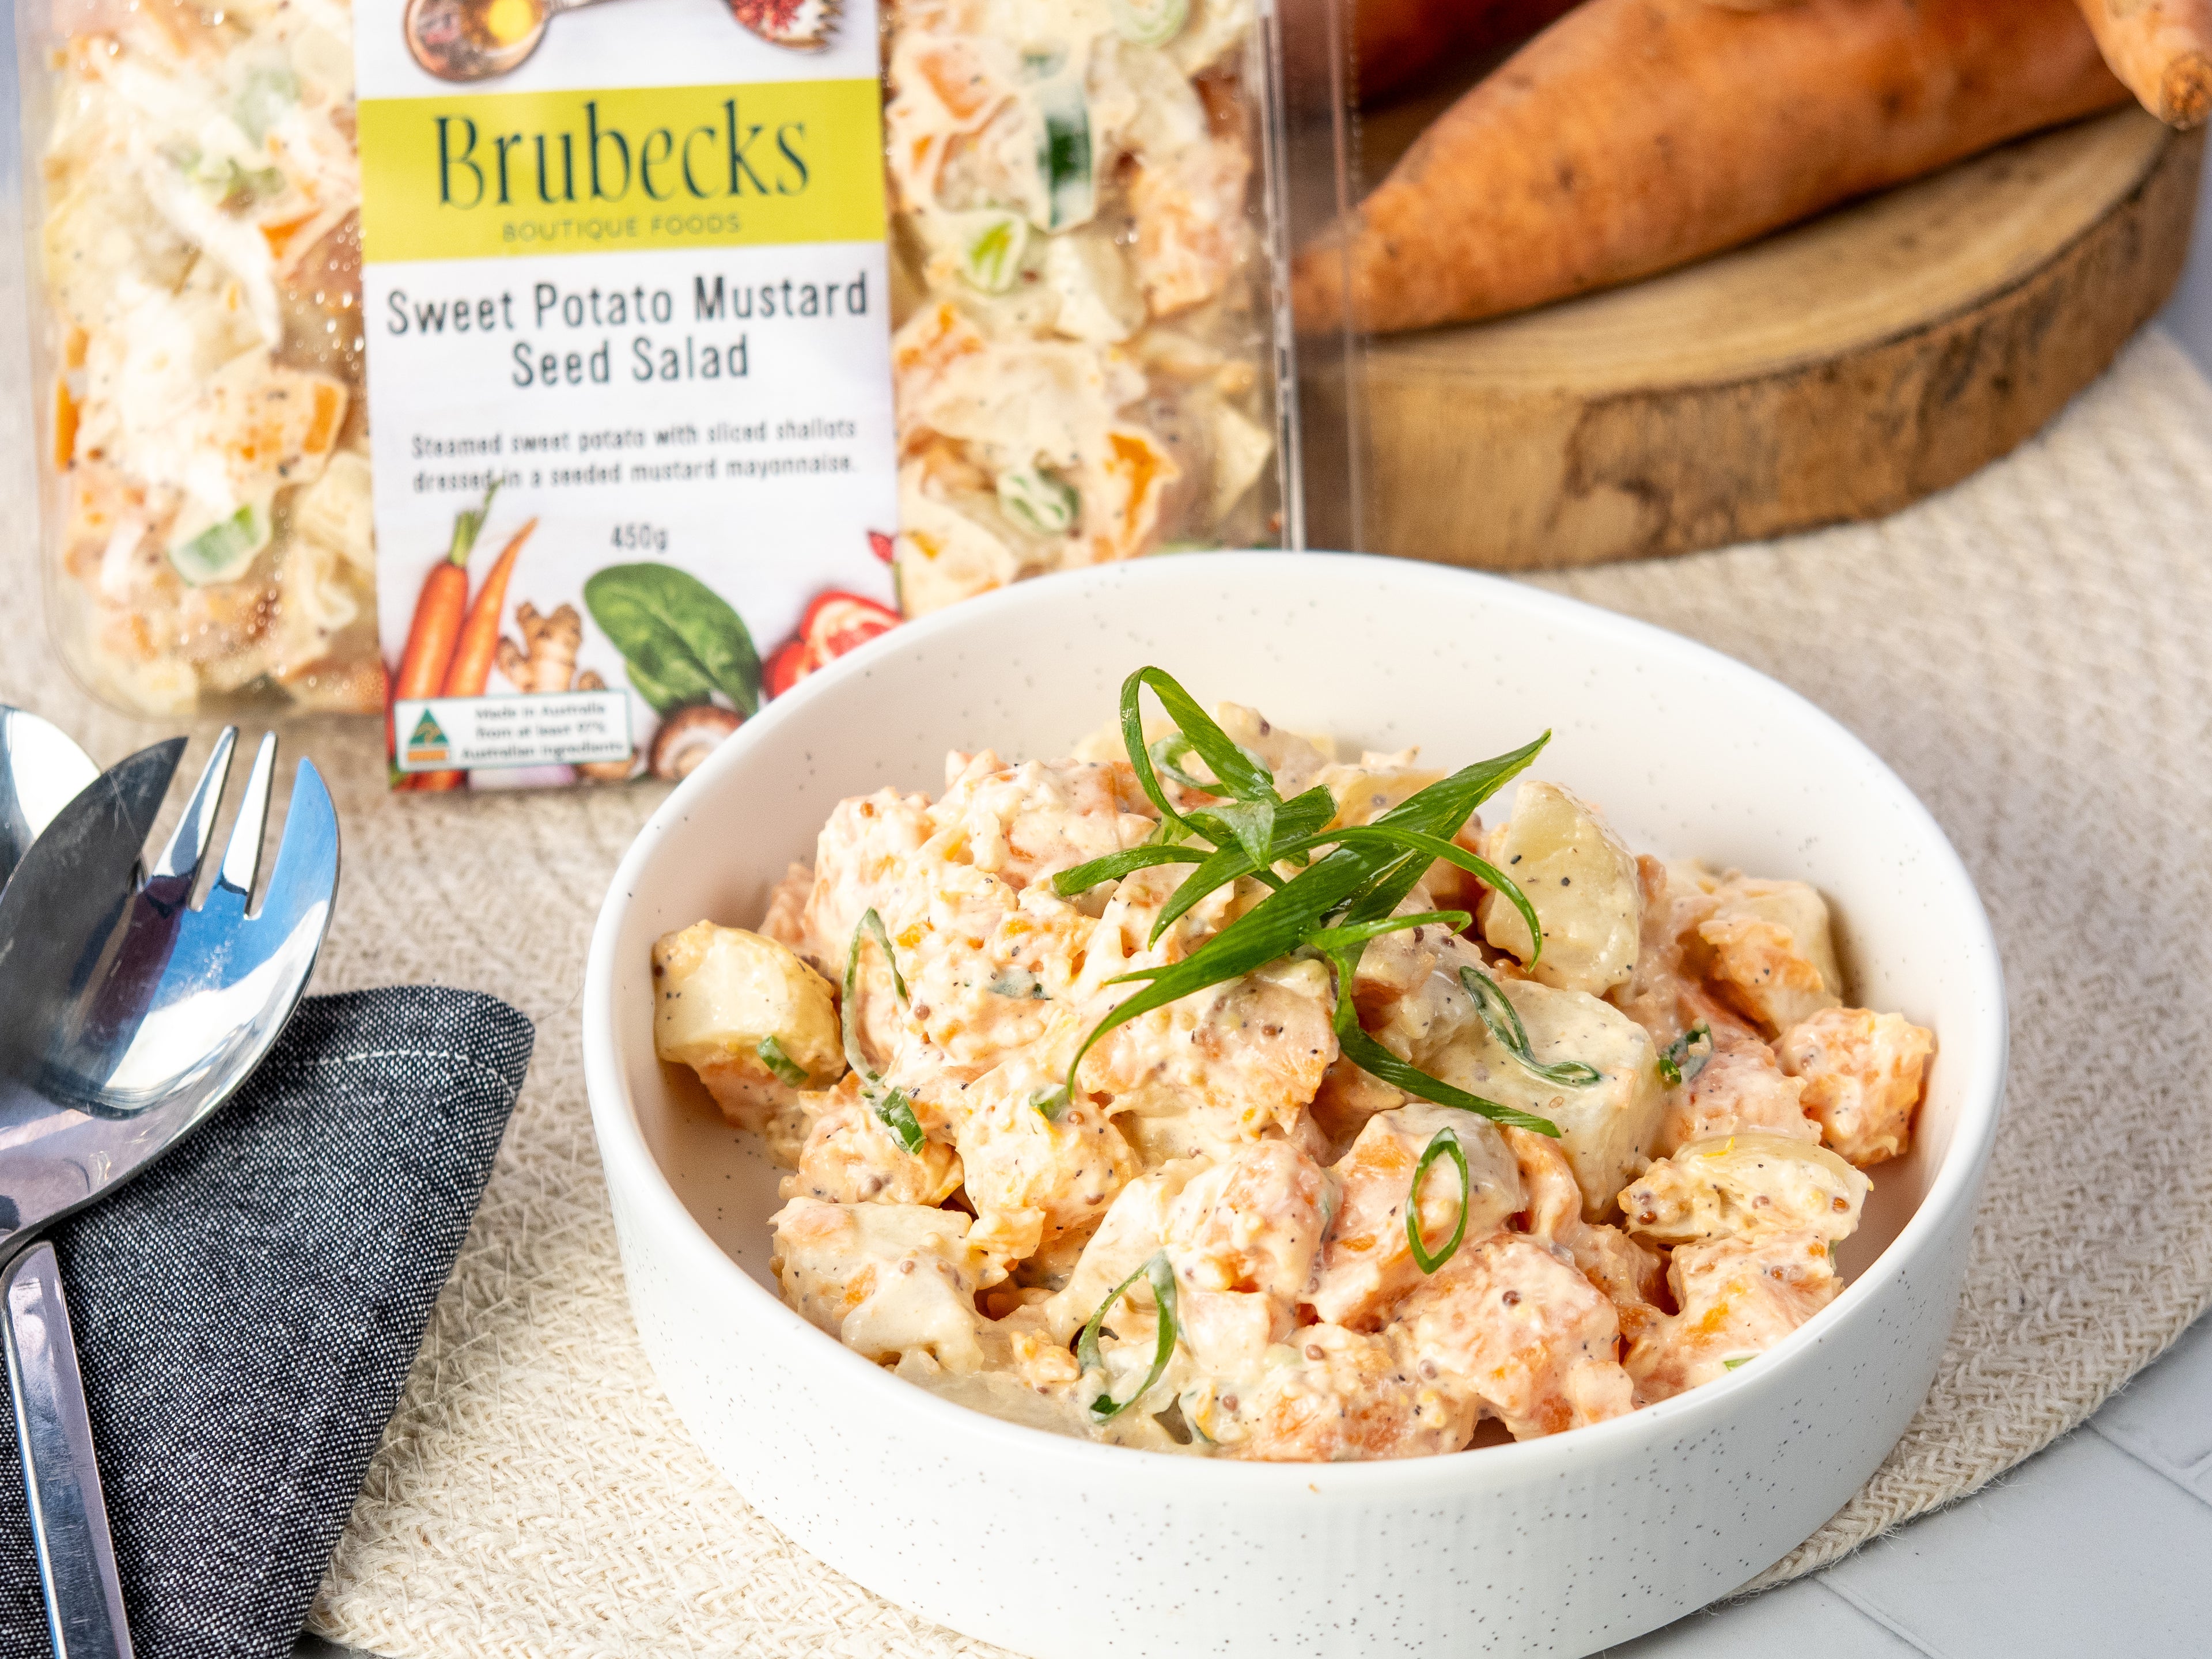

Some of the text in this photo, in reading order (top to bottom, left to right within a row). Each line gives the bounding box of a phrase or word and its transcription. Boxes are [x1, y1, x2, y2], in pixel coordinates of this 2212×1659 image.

[433, 98, 810, 210] Brubecks
[502, 213, 741, 243] BOUTIQUE FOODS
[387, 272, 868, 335] Sweet Potato Mustard
[511, 334, 748, 387] Seed Salad
[413, 432, 502, 459] Steamed
[512, 432, 569, 453] sweet
[654, 423, 699, 445] with
[708, 421, 766, 444] sliced
[776, 418, 855, 440] shallots
[414, 468, 494, 493] dressed
[530, 469, 542, 487] a
[551, 463, 622, 487] seeded
[632, 457, 717, 482] mustard
[610, 522, 668, 553] 450g
